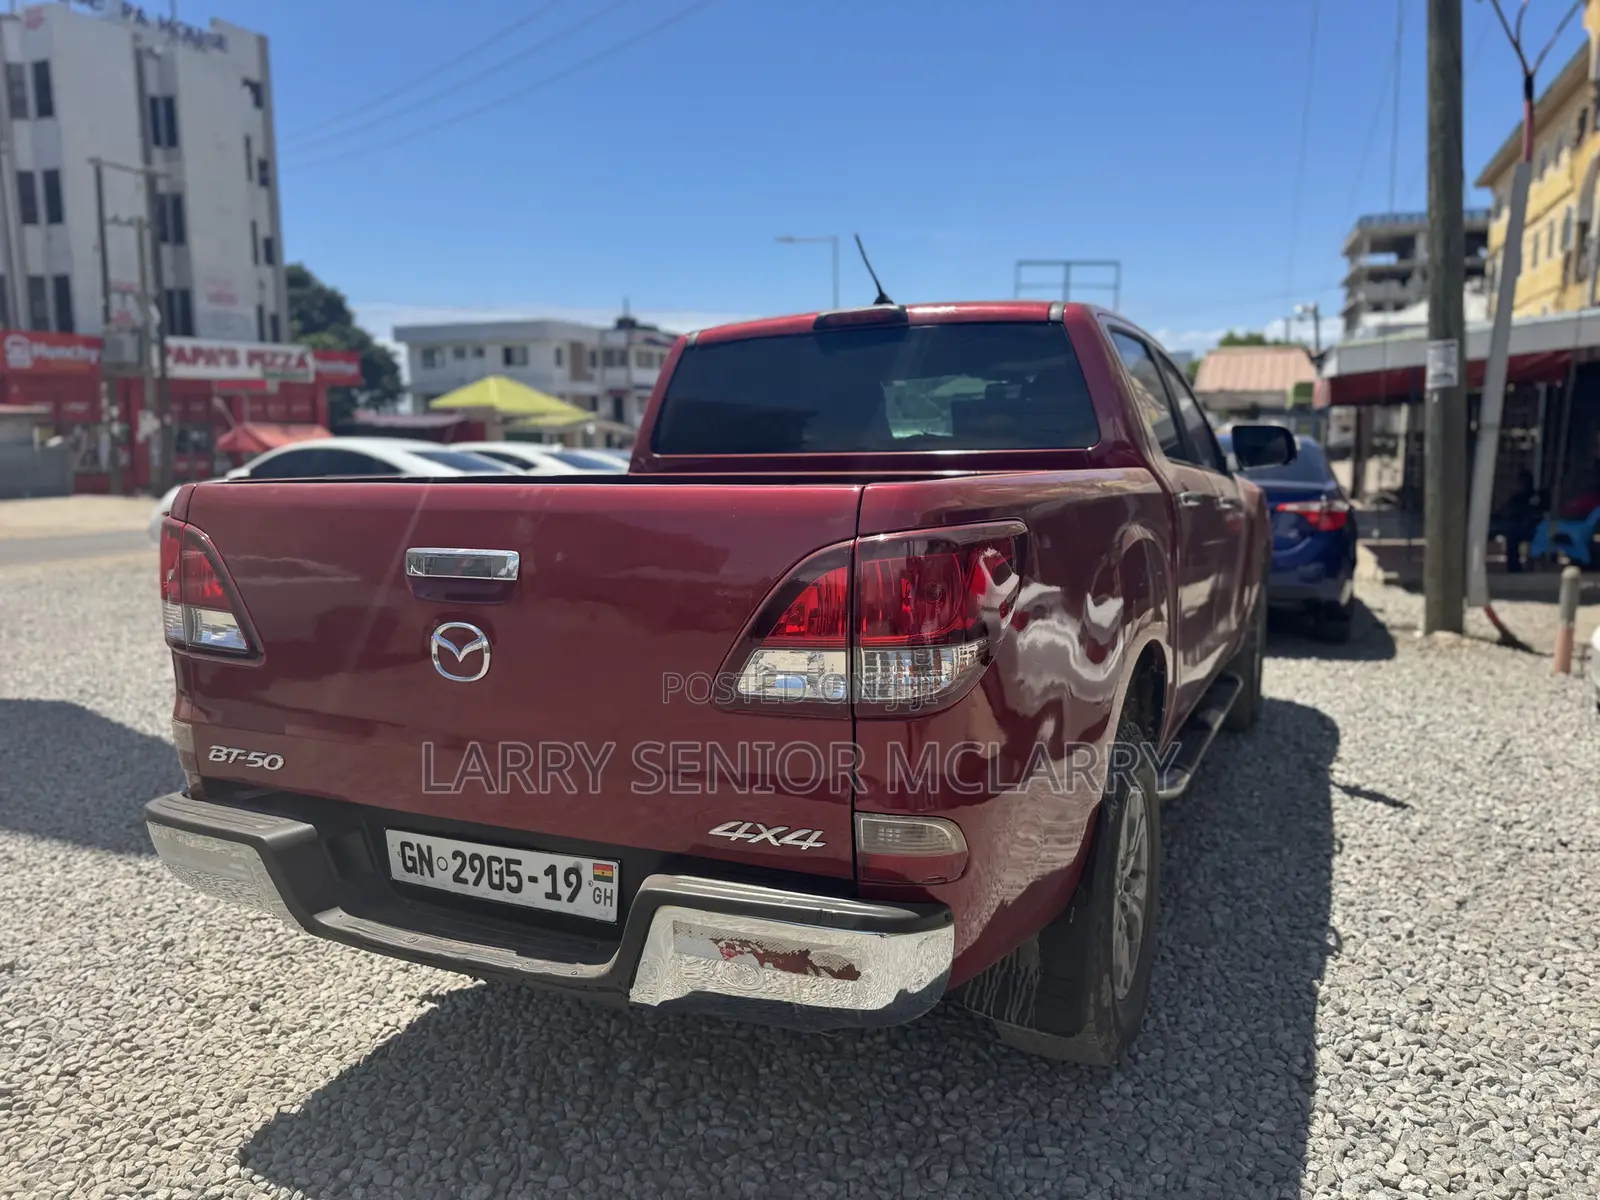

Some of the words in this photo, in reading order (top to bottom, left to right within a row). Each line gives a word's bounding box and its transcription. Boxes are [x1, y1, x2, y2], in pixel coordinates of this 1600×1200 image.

[246, 349, 310, 370] PIZZA
[208, 744, 285, 771] BT-50
[399, 840, 436, 879] GN
[451, 849, 583, 904] 2905-19
[592, 886, 614, 908] GH
